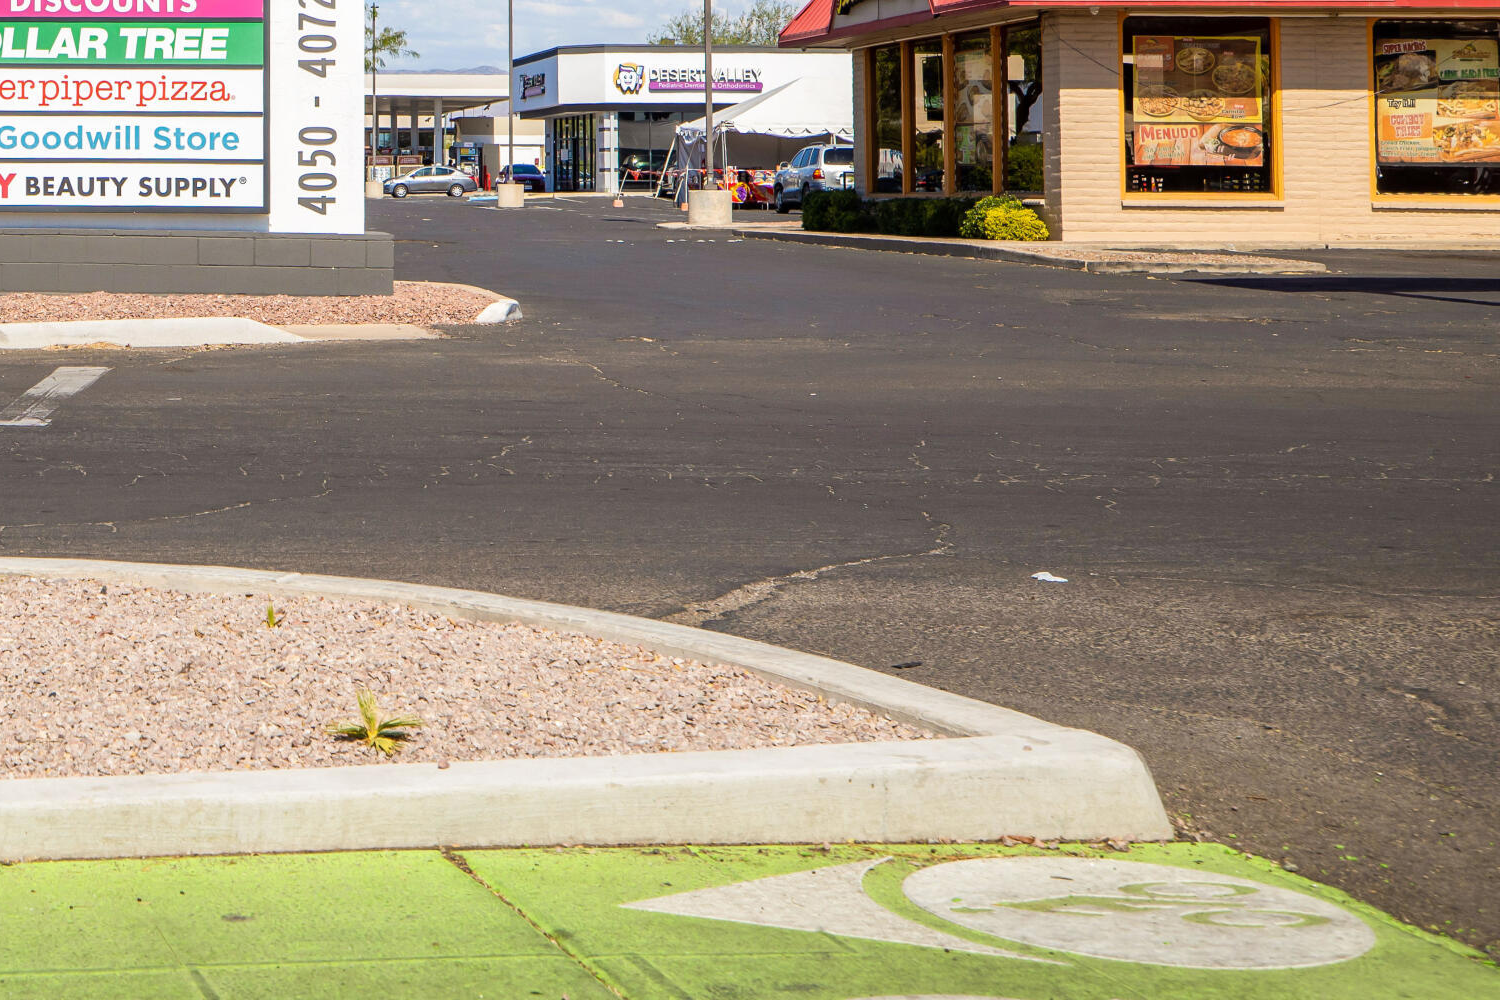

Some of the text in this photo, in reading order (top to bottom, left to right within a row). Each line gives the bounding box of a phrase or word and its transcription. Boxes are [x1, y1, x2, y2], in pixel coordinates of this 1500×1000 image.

[119, 27, 229, 60] TREE
[649, 68, 761, 83] DESERT VALLEY
[153, 126, 240, 151] Store
[298, 126, 337, 215] 4050
[25, 177, 128, 198] BEAUTY
